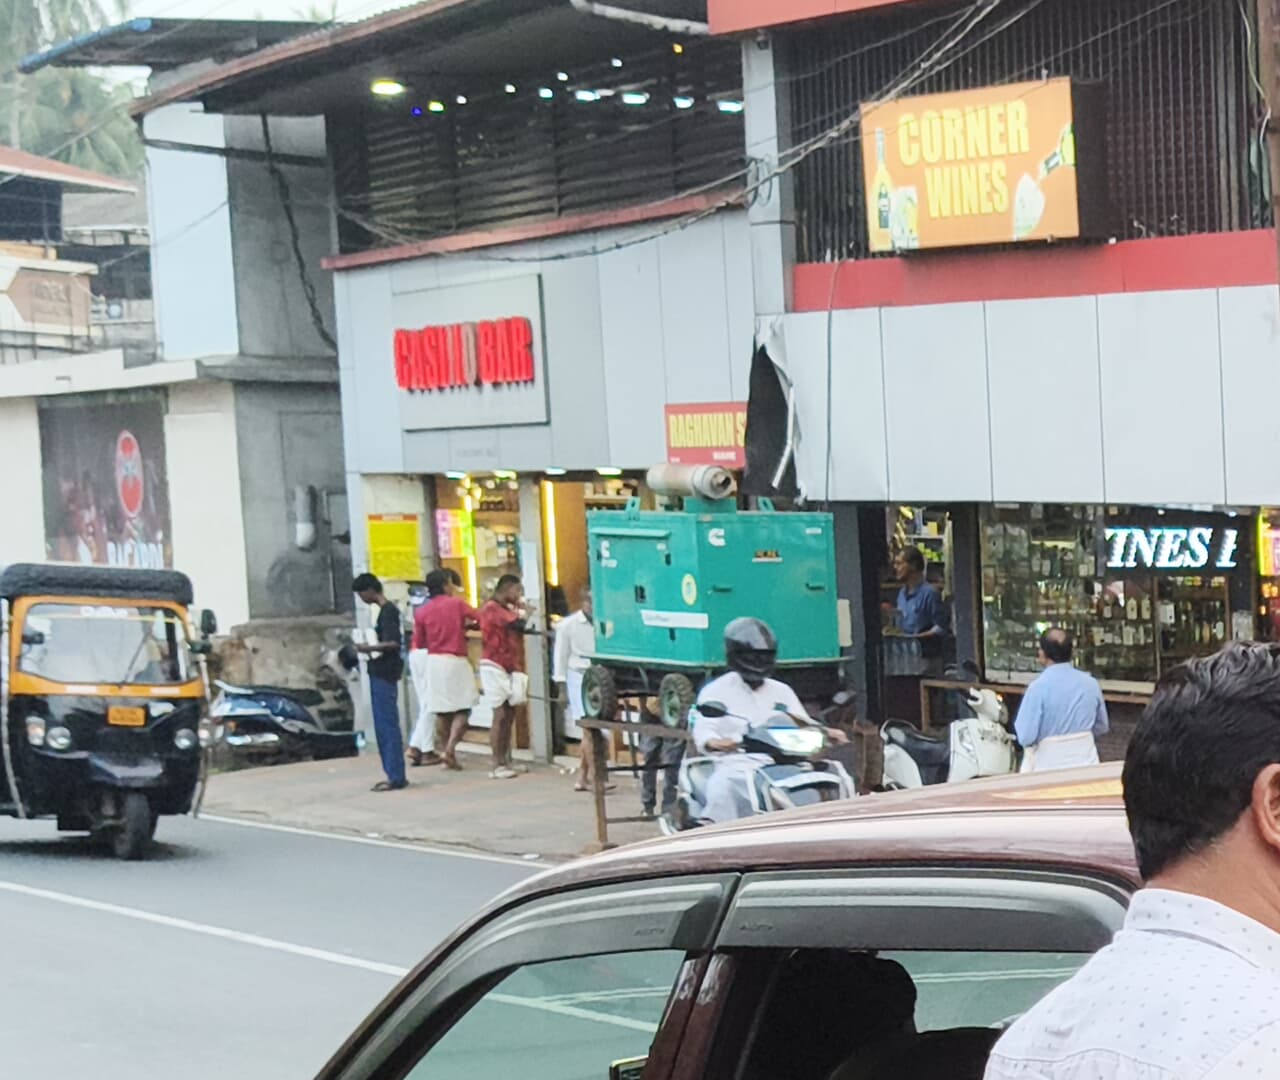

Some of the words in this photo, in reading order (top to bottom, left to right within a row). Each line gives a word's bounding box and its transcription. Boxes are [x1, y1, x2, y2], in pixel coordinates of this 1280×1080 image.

[898, 99, 1030, 166] CORNER
[924, 159, 1009, 218] WINES
[477, 316, 535, 385] BAR
